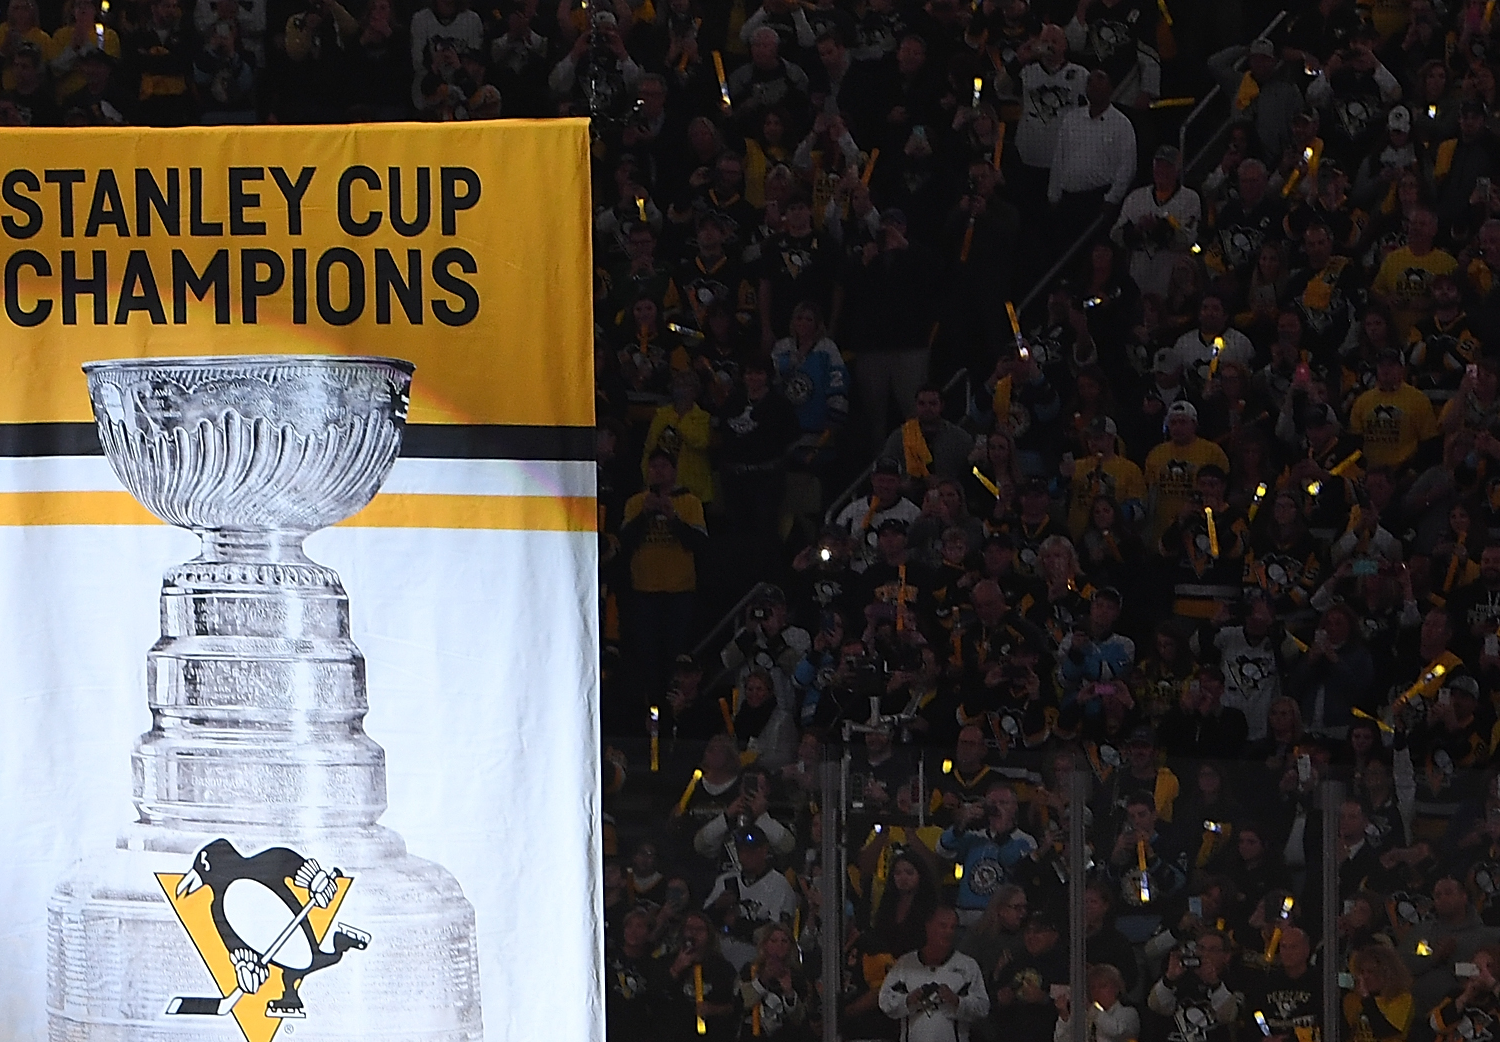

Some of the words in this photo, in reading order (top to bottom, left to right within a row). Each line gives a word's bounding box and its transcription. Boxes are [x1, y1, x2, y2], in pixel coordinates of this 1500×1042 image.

[1, 165, 317, 240] STANLEY
[335, 164, 484, 238] CUP
[3, 246, 481, 328] CHAMPIONS
